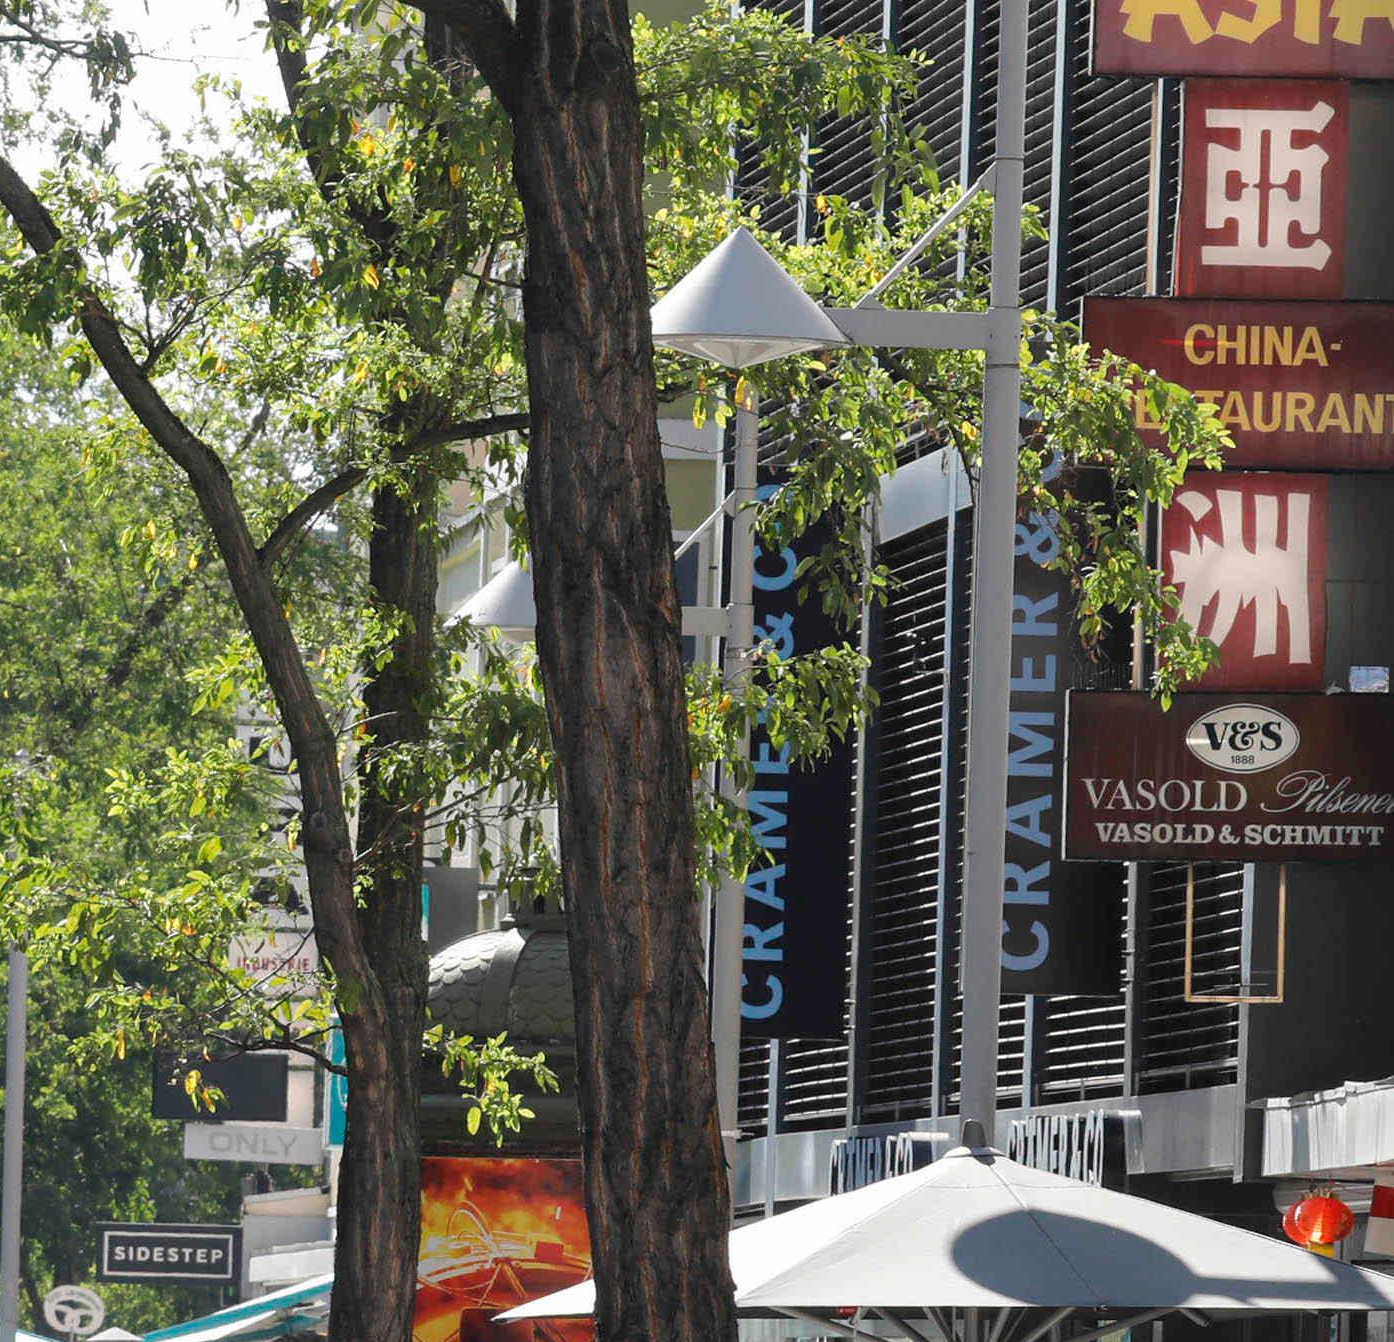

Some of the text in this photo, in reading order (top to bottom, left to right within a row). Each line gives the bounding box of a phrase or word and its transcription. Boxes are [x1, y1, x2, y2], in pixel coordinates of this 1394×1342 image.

[1184, 324, 1341, 367] CHINA-
[1202, 721, 1282, 751] V&S
[1231, 755, 1254, 765] 1888
[1001, 591, 1059, 972] CRAMER
[1082, 778, 1247, 812] VASOLD
[1095, 822, 1384, 847] VASOLD & SCHMITT
[210, 1131, 299, 1155] ONLY
[115, 1246, 223, 1264] SIDESTEP
